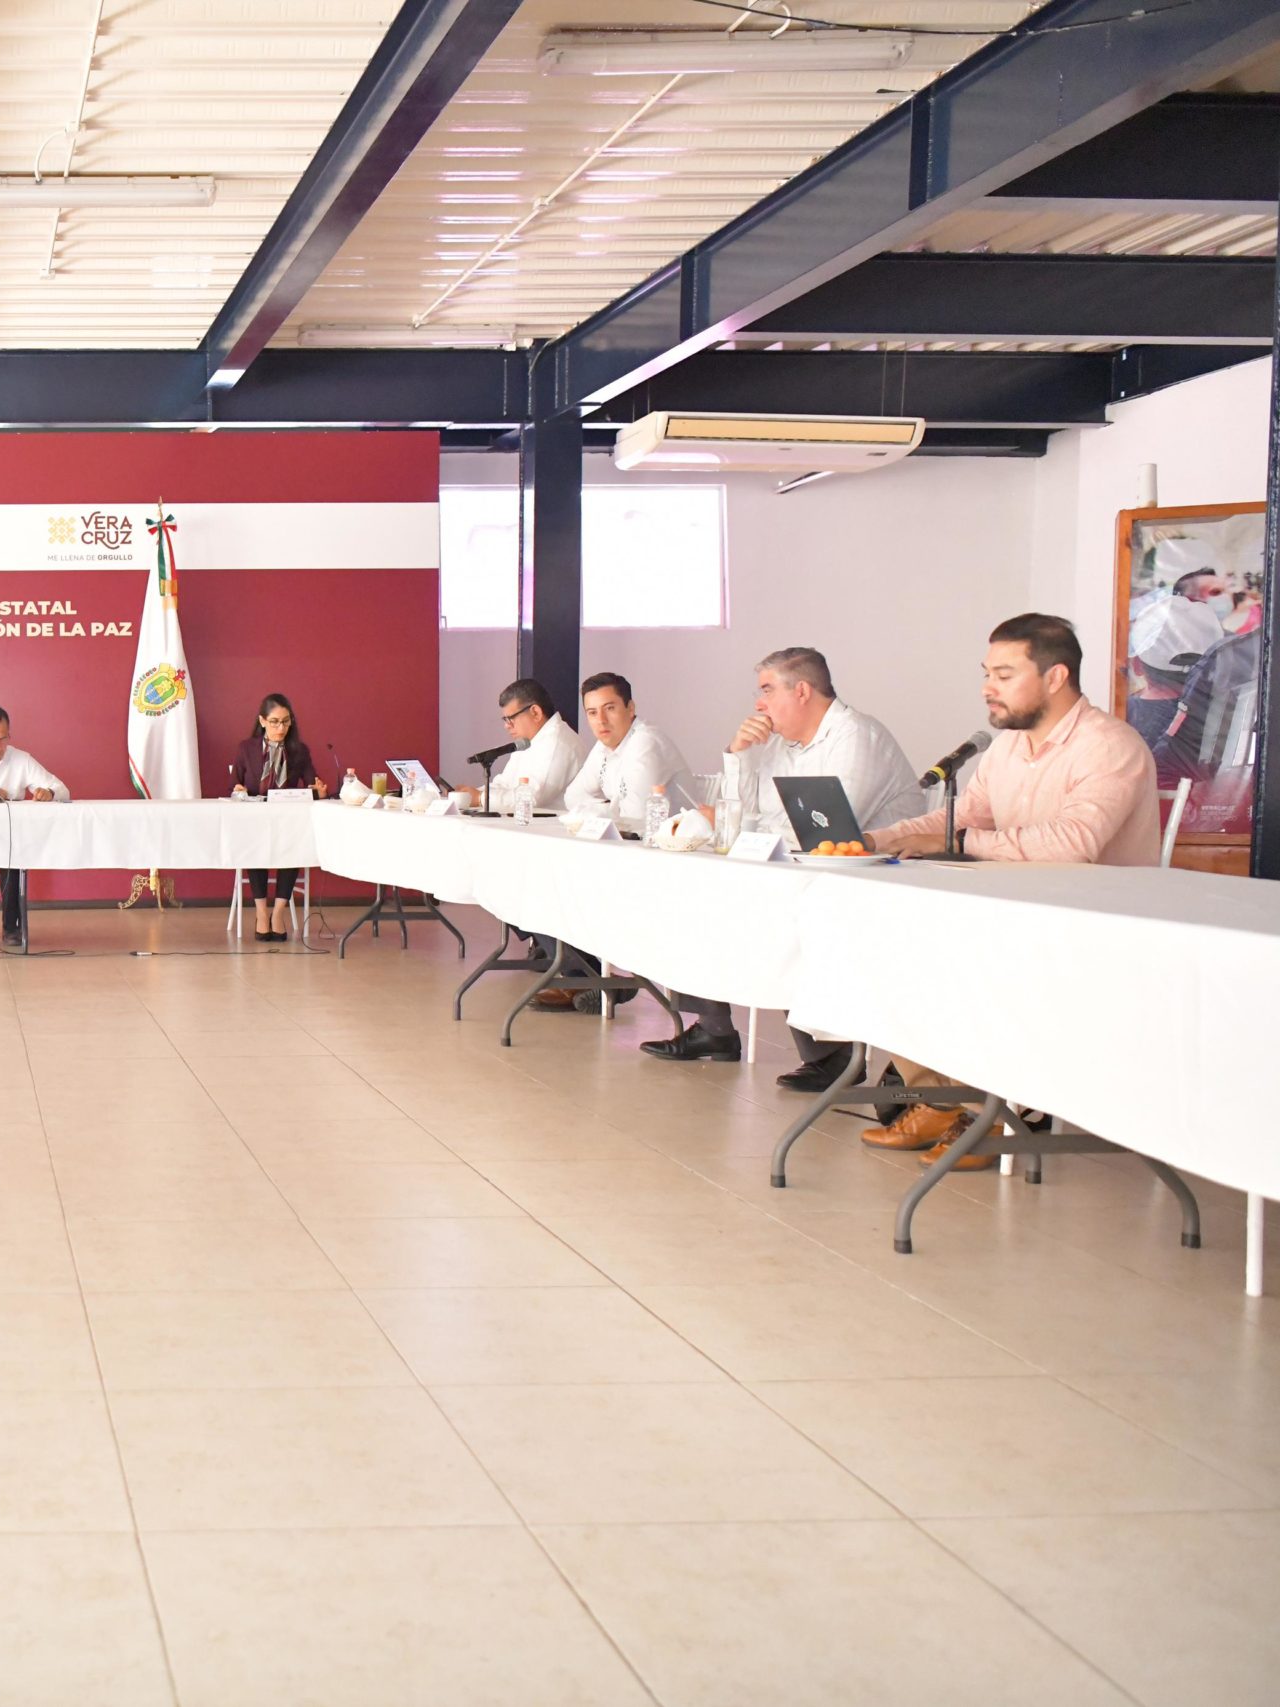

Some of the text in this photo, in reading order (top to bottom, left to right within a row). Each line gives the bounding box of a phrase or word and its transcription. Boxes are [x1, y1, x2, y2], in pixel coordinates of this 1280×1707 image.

[81, 511, 133, 530] VERA
[81, 531, 133, 550] CRUZ
[26, 623, 54, 637] DE
[59, 622, 86, 637] LA
[90, 622, 133, 637] PAZ
